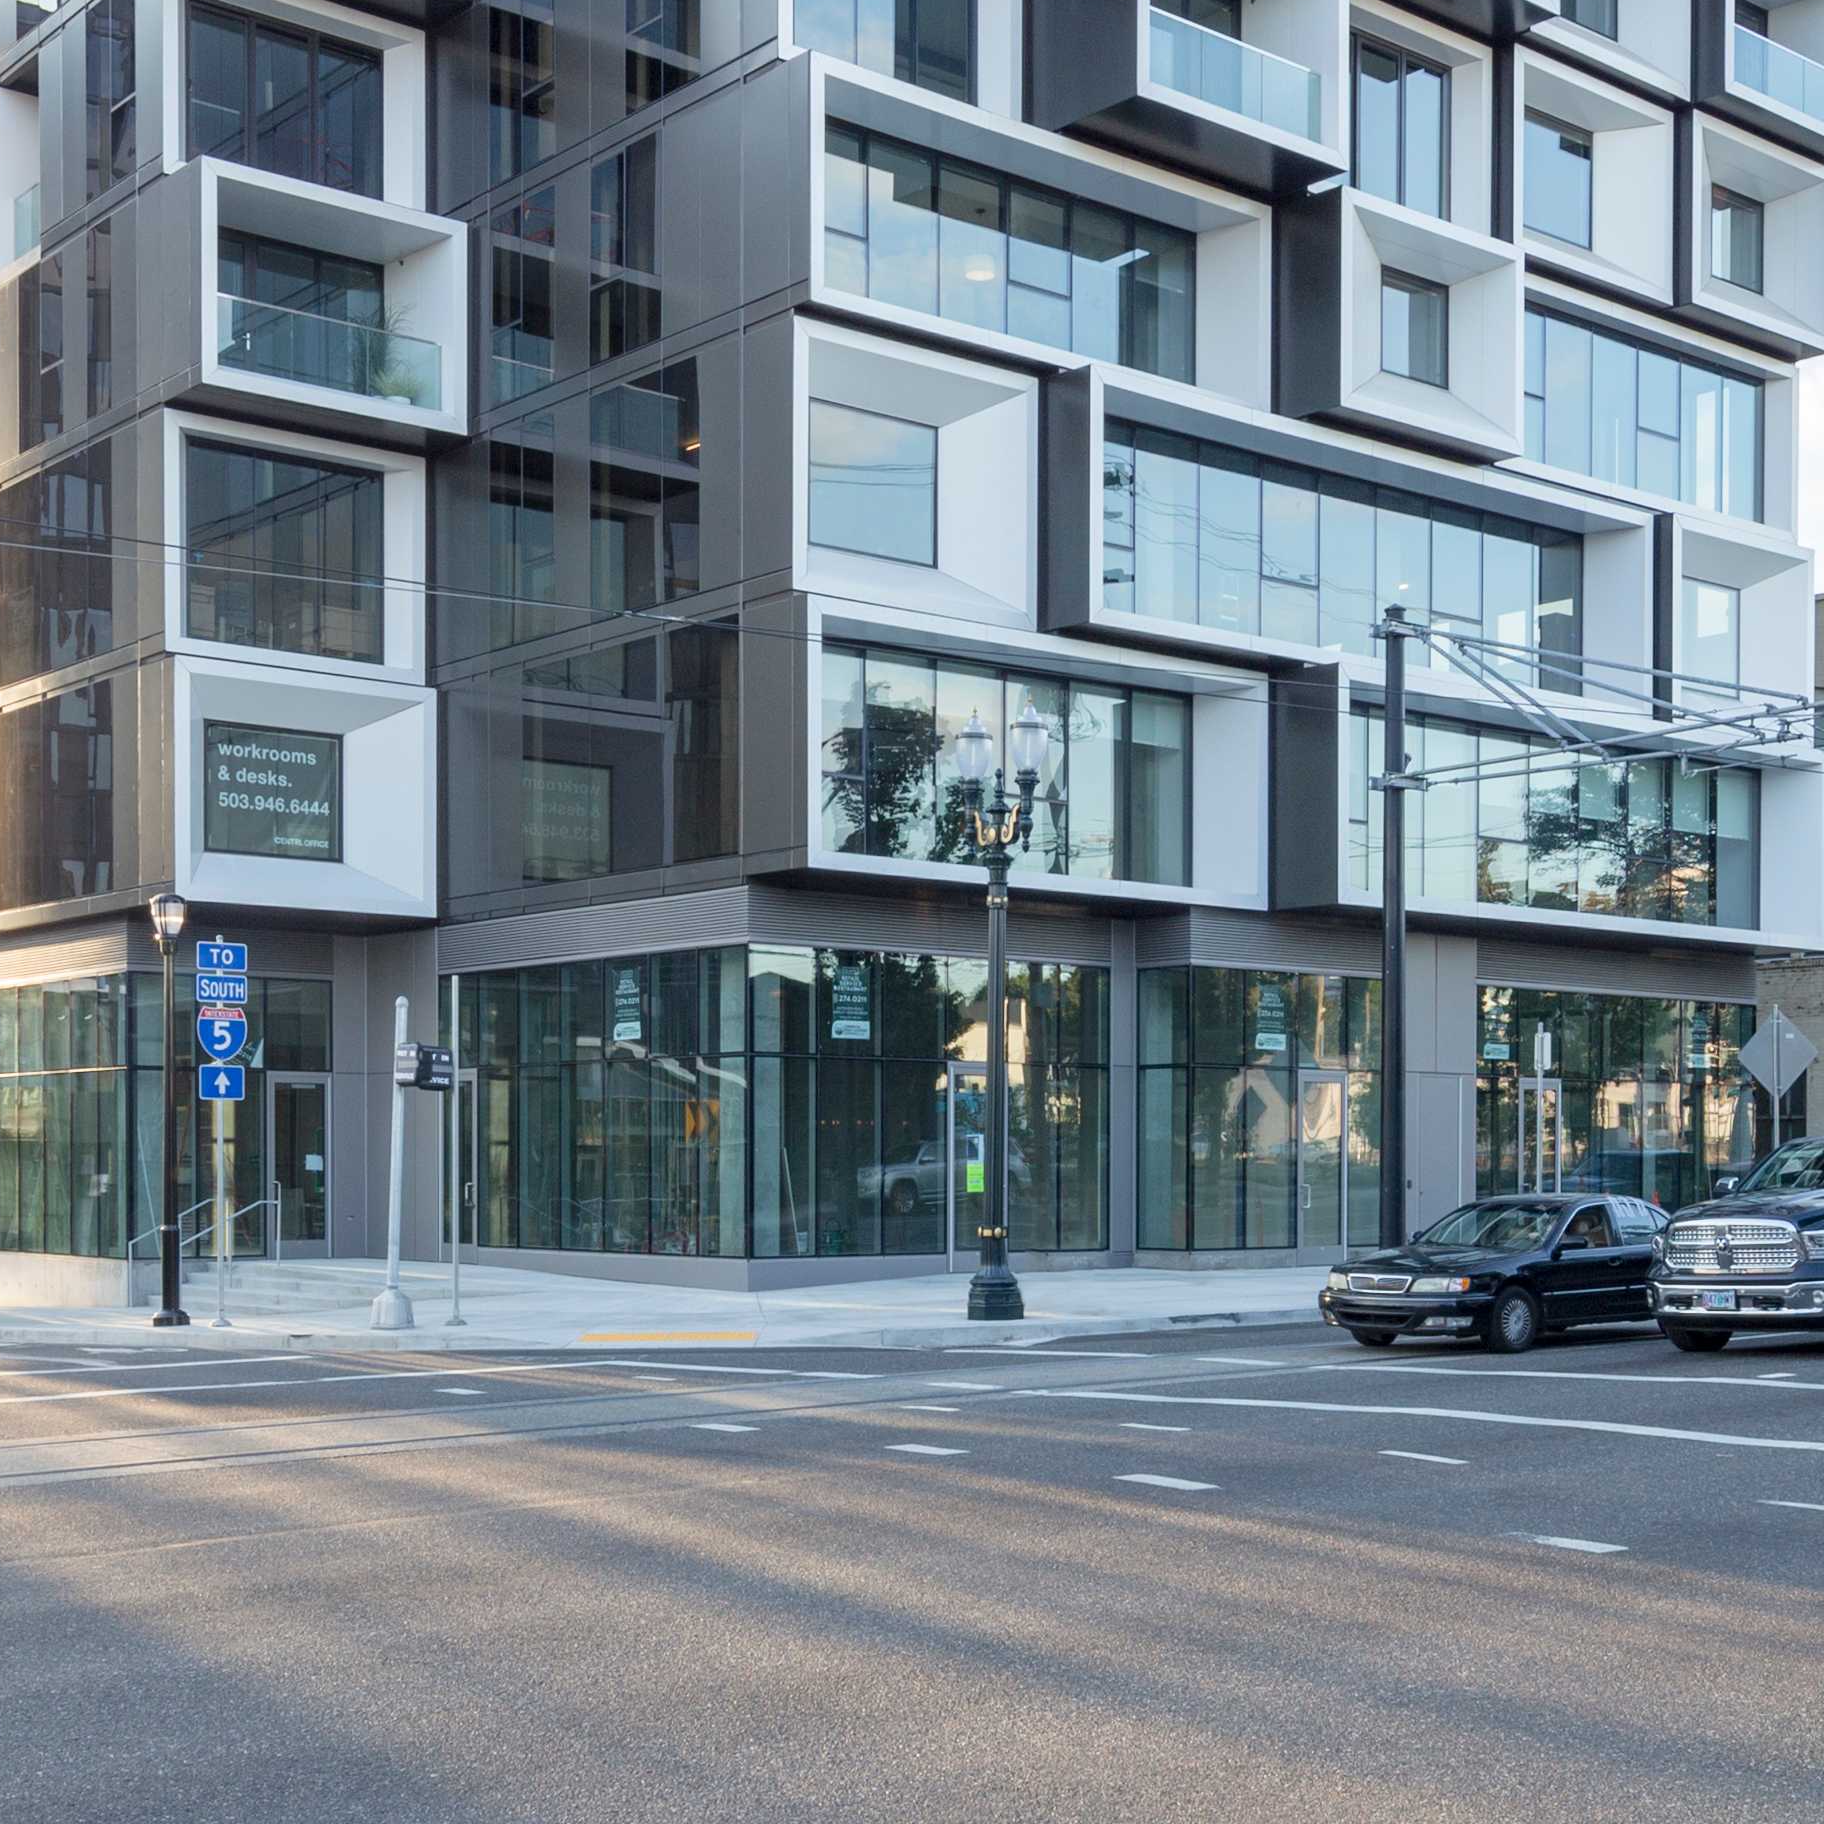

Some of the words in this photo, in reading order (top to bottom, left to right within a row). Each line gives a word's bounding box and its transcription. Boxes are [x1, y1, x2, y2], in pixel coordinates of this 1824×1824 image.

[217, 743, 317, 765] workrooms
[217, 765, 230, 781] &
[236, 768, 292, 787] desks.
[218, 792, 330, 816] 503.946.6444
[209, 948, 234, 965] TO
[200, 979, 244, 998] SOUTH
[213, 1021, 232, 1051] 5
